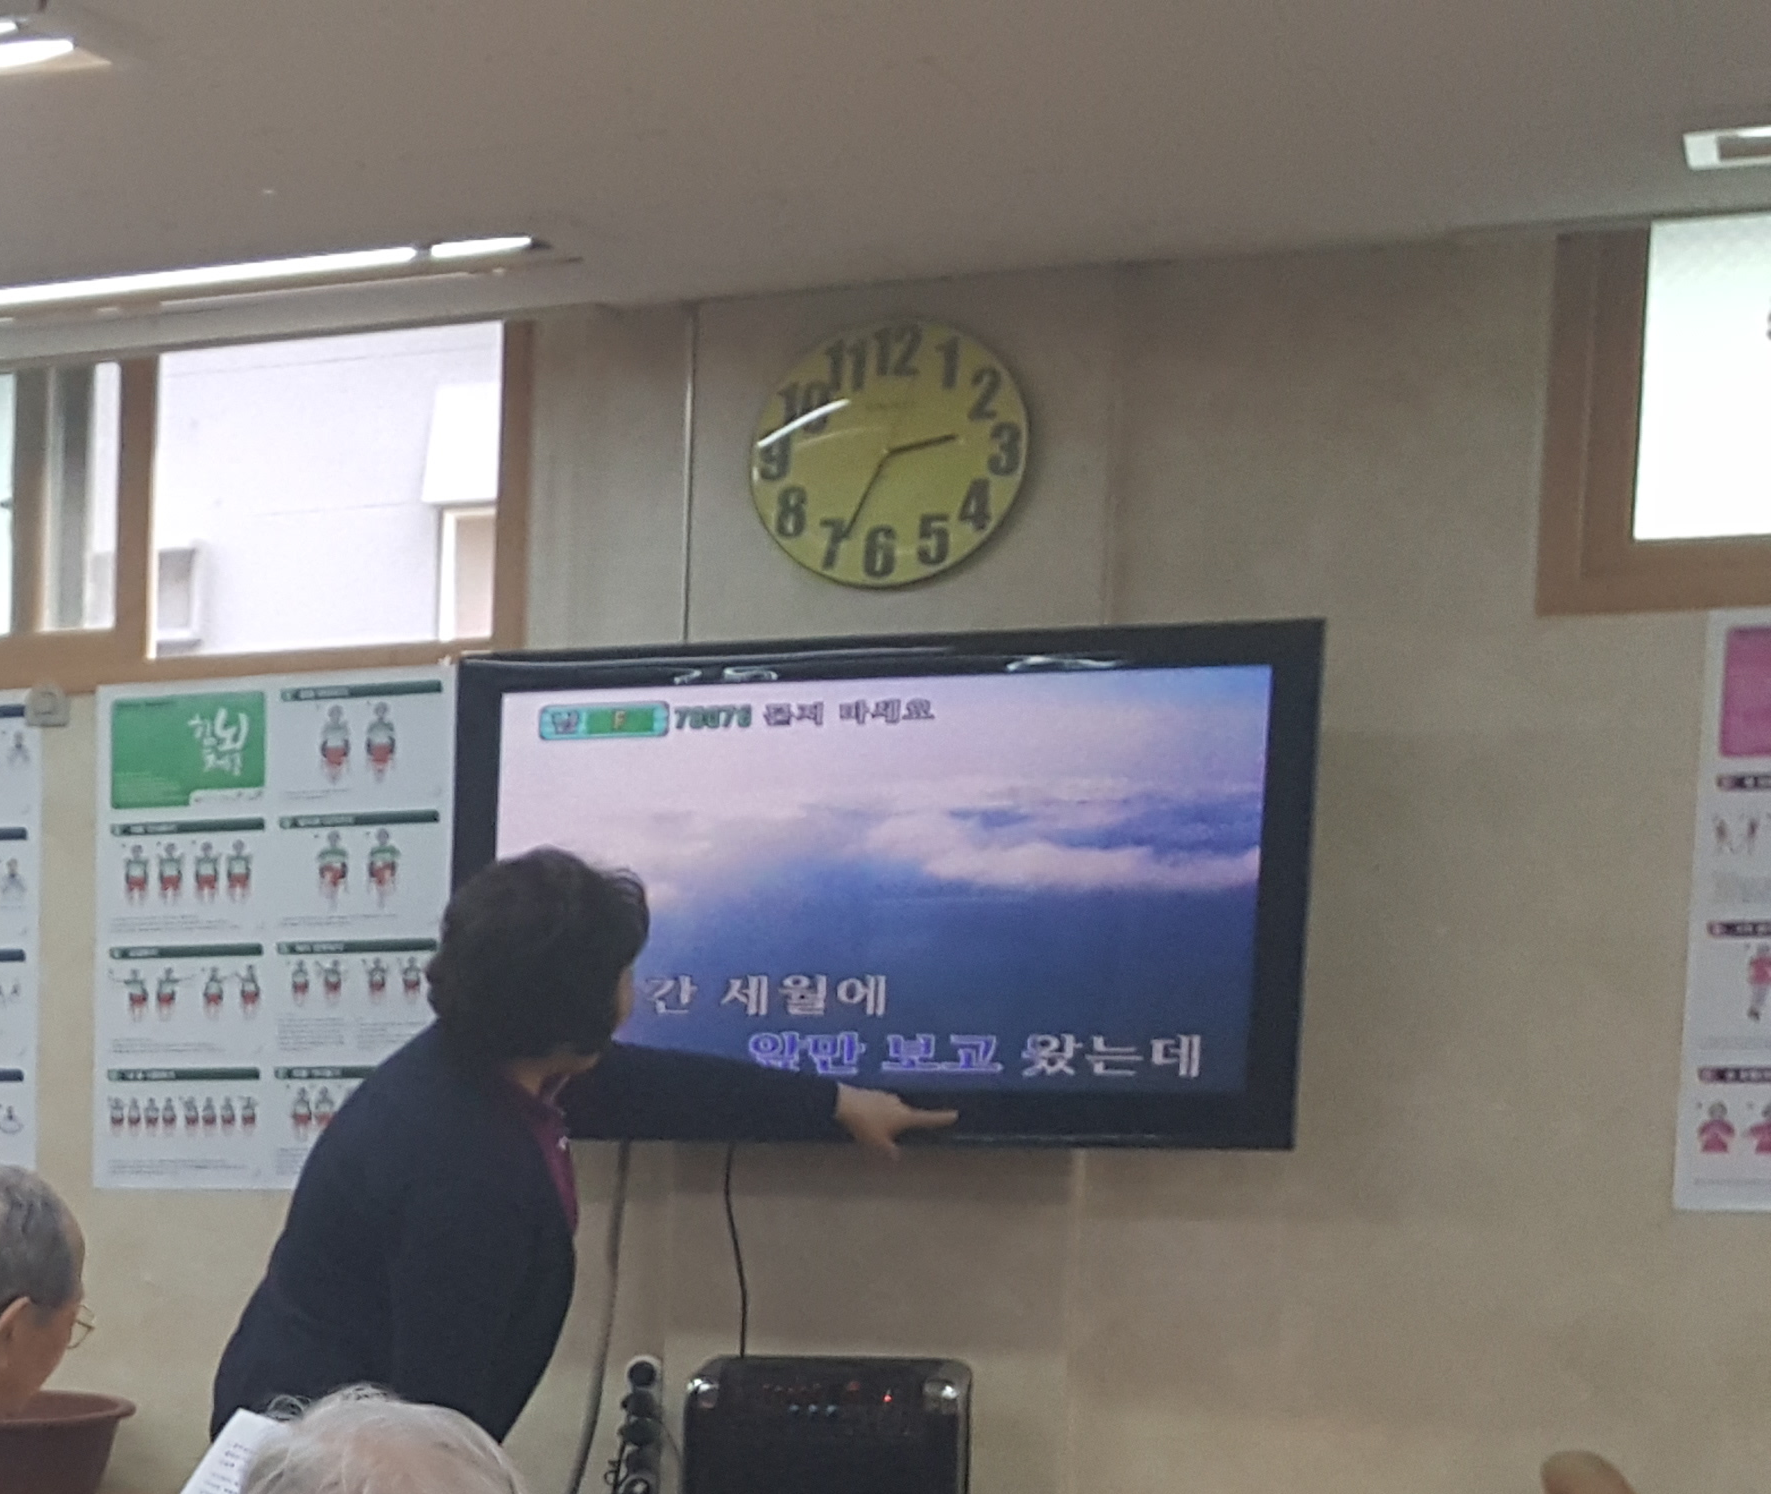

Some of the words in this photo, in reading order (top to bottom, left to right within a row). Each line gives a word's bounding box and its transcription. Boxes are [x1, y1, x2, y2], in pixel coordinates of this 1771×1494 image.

[824, 338, 868, 392] 11
[874, 325, 923, 377] 12
[935, 336, 960, 390] 1
[968, 367, 1002, 421] 2
[987, 422, 1022, 477] 3
[775, 486, 807, 539] 8
[959, 477, 991, 532] 4
[819, 517, 850, 571] 7
[863, 524, 897, 578] 6
[917, 513, 951, 566] 5
[721, 974, 888, 1017] 세월에
[881, 1032, 1005, 1076] 보고
[1022, 1032, 1203, 1078] 왔는데
